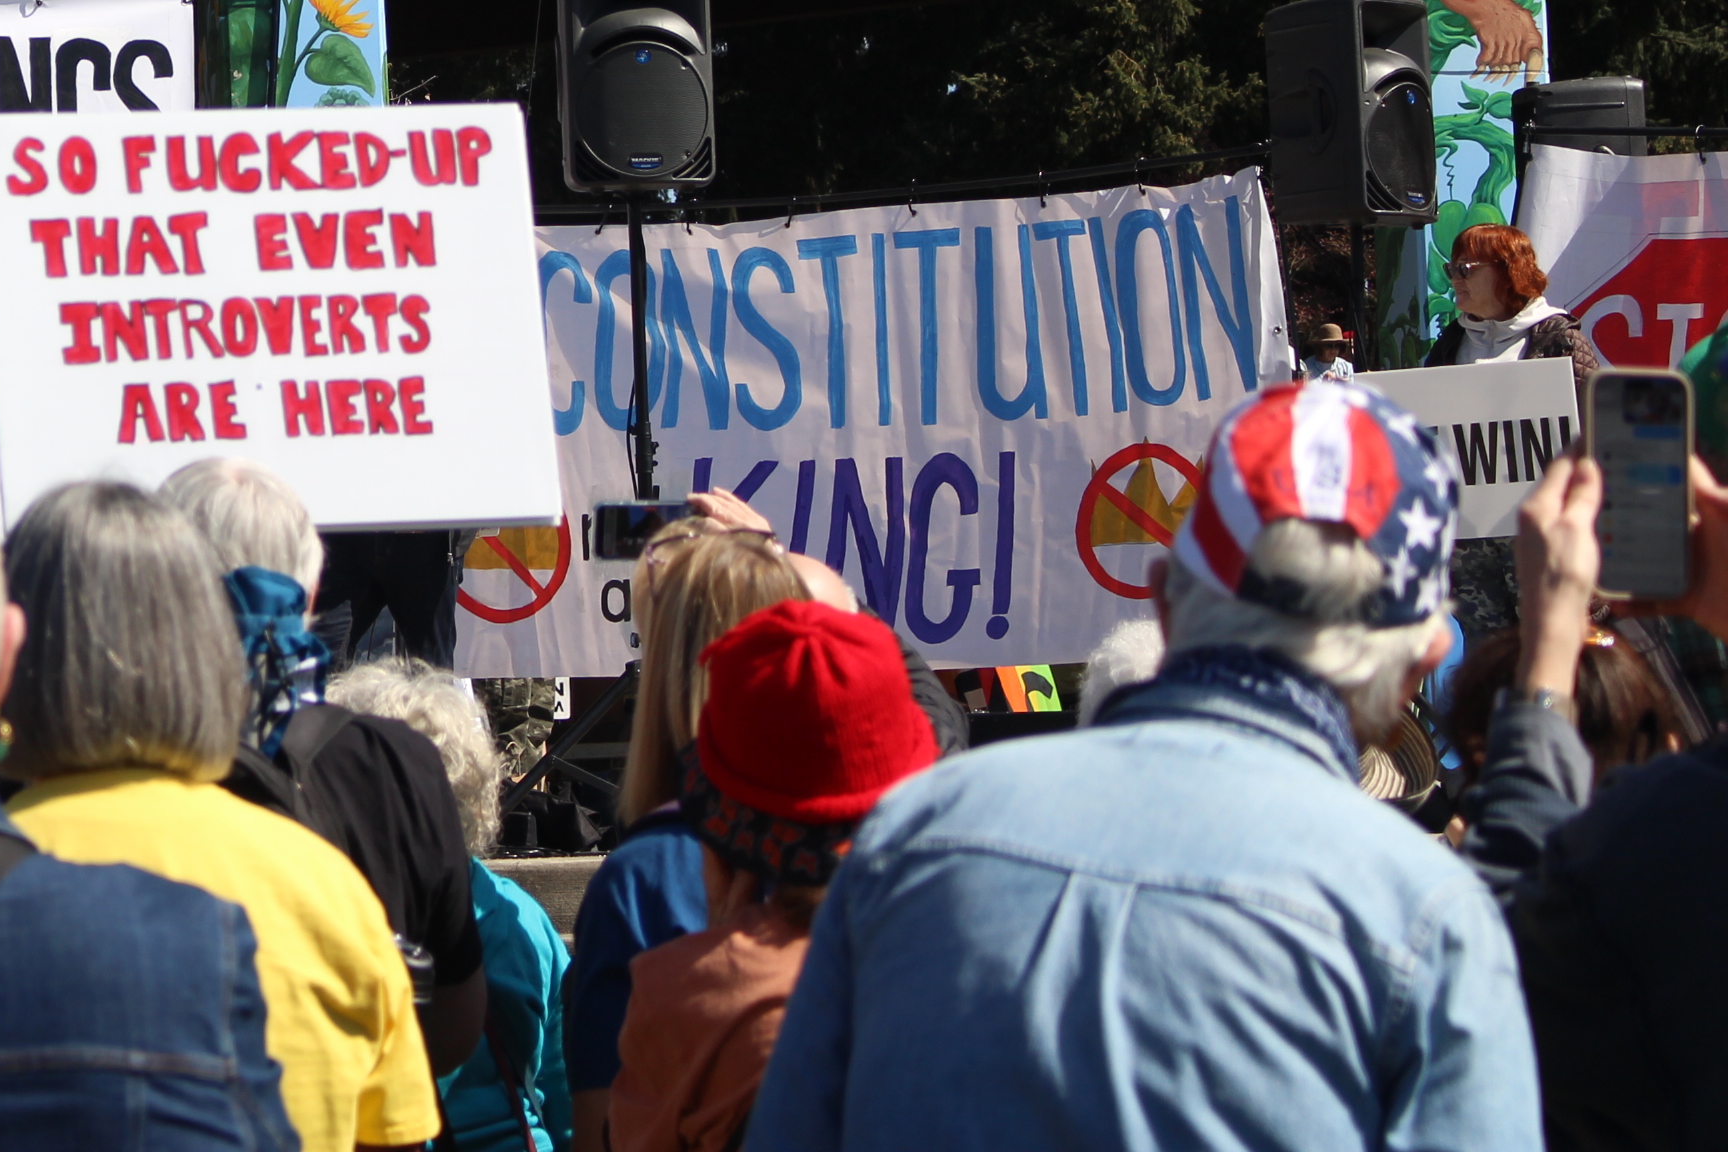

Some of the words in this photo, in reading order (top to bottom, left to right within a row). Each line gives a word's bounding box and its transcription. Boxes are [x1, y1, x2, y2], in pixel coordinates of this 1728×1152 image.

[6, 135, 98, 196] SO
[121, 126, 493, 194] FUCKED-UP
[30, 211, 208, 278] THAT
[254, 208, 437, 272] EVEN
[59, 293, 432, 365] INTROVERTS
[538, 195, 1260, 436] CONSTITUTION
[118, 379, 248, 444] ARE
[280, 376, 434, 438] HERE
[692, 451, 1016, 645] KING!
